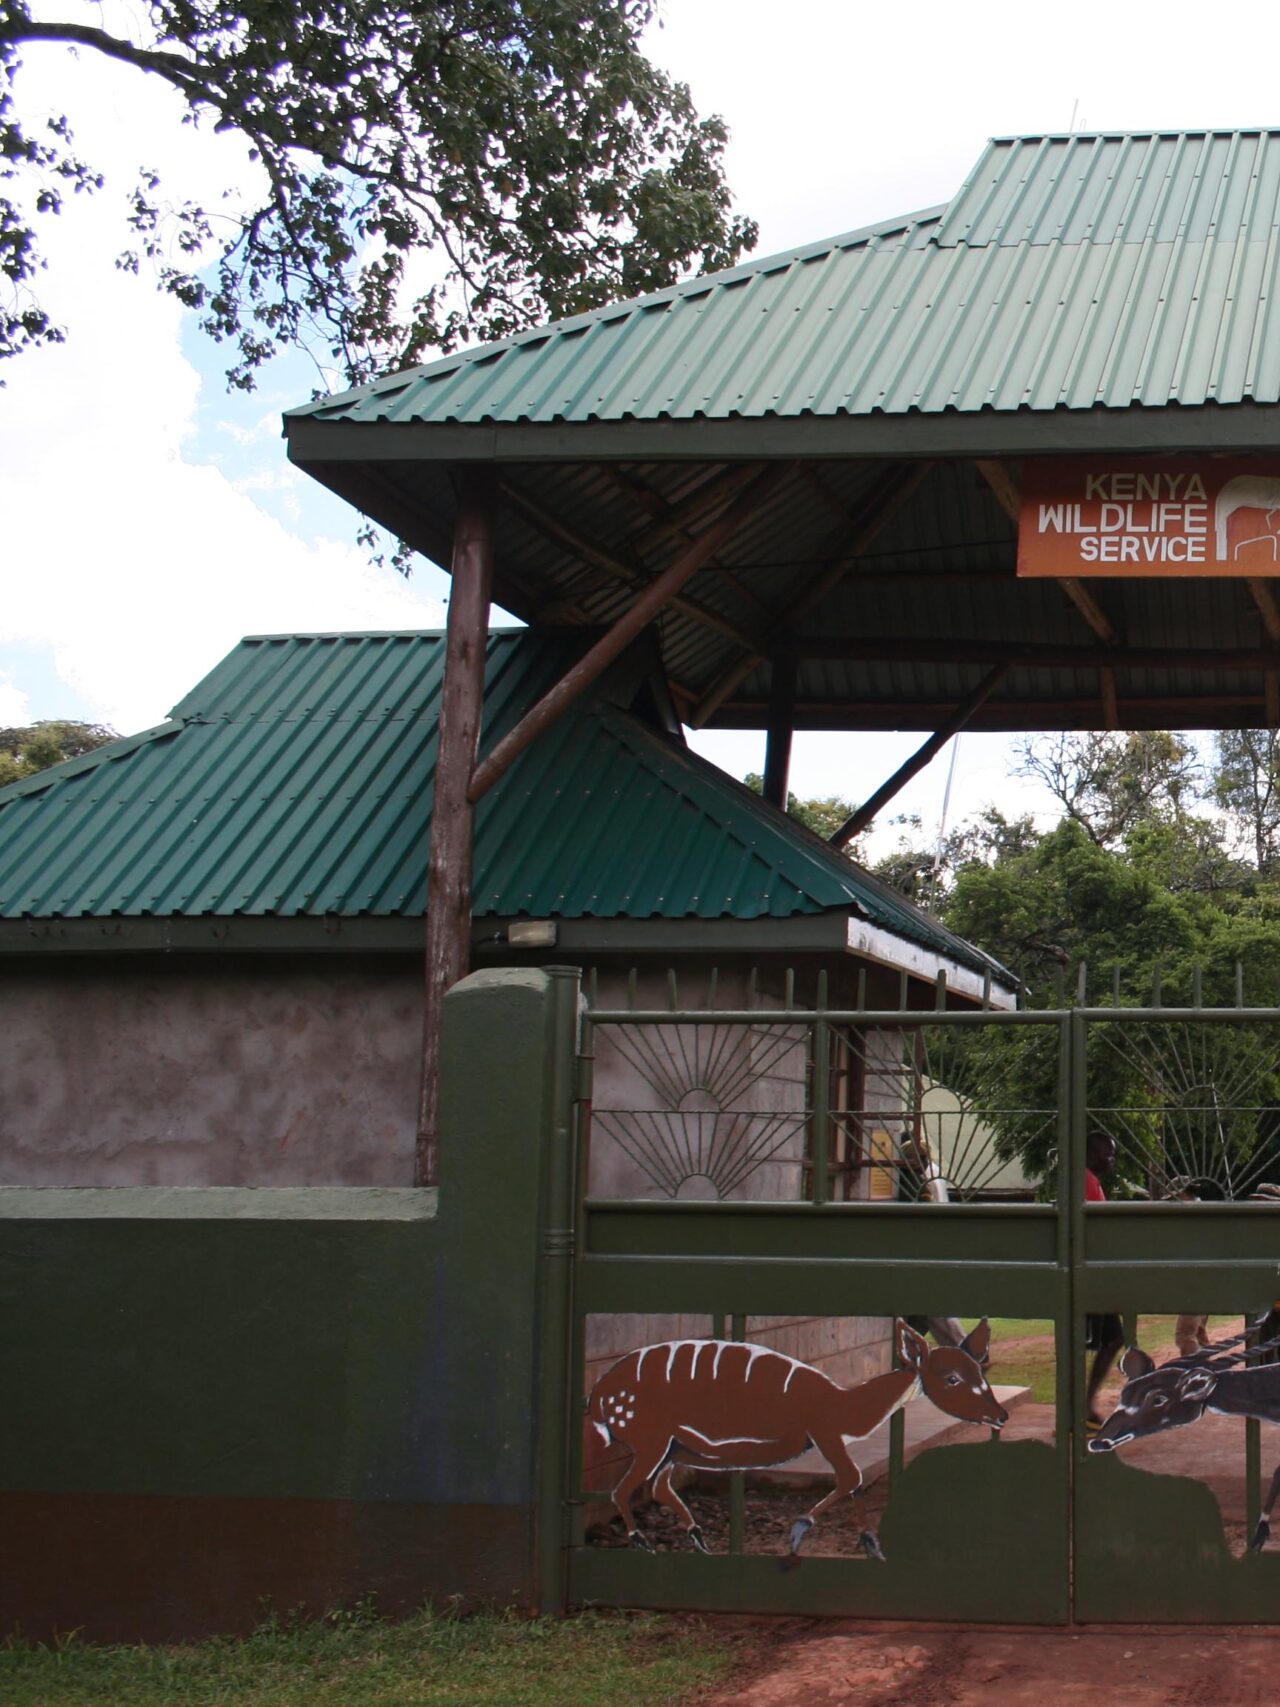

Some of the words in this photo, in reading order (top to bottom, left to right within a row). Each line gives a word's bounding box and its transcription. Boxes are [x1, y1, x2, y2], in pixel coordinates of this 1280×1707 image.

[1085, 473, 1207, 501] KENYA
[1038, 503, 1208, 533] WILDLIFE
[1080, 535, 1206, 563] SERVICE
